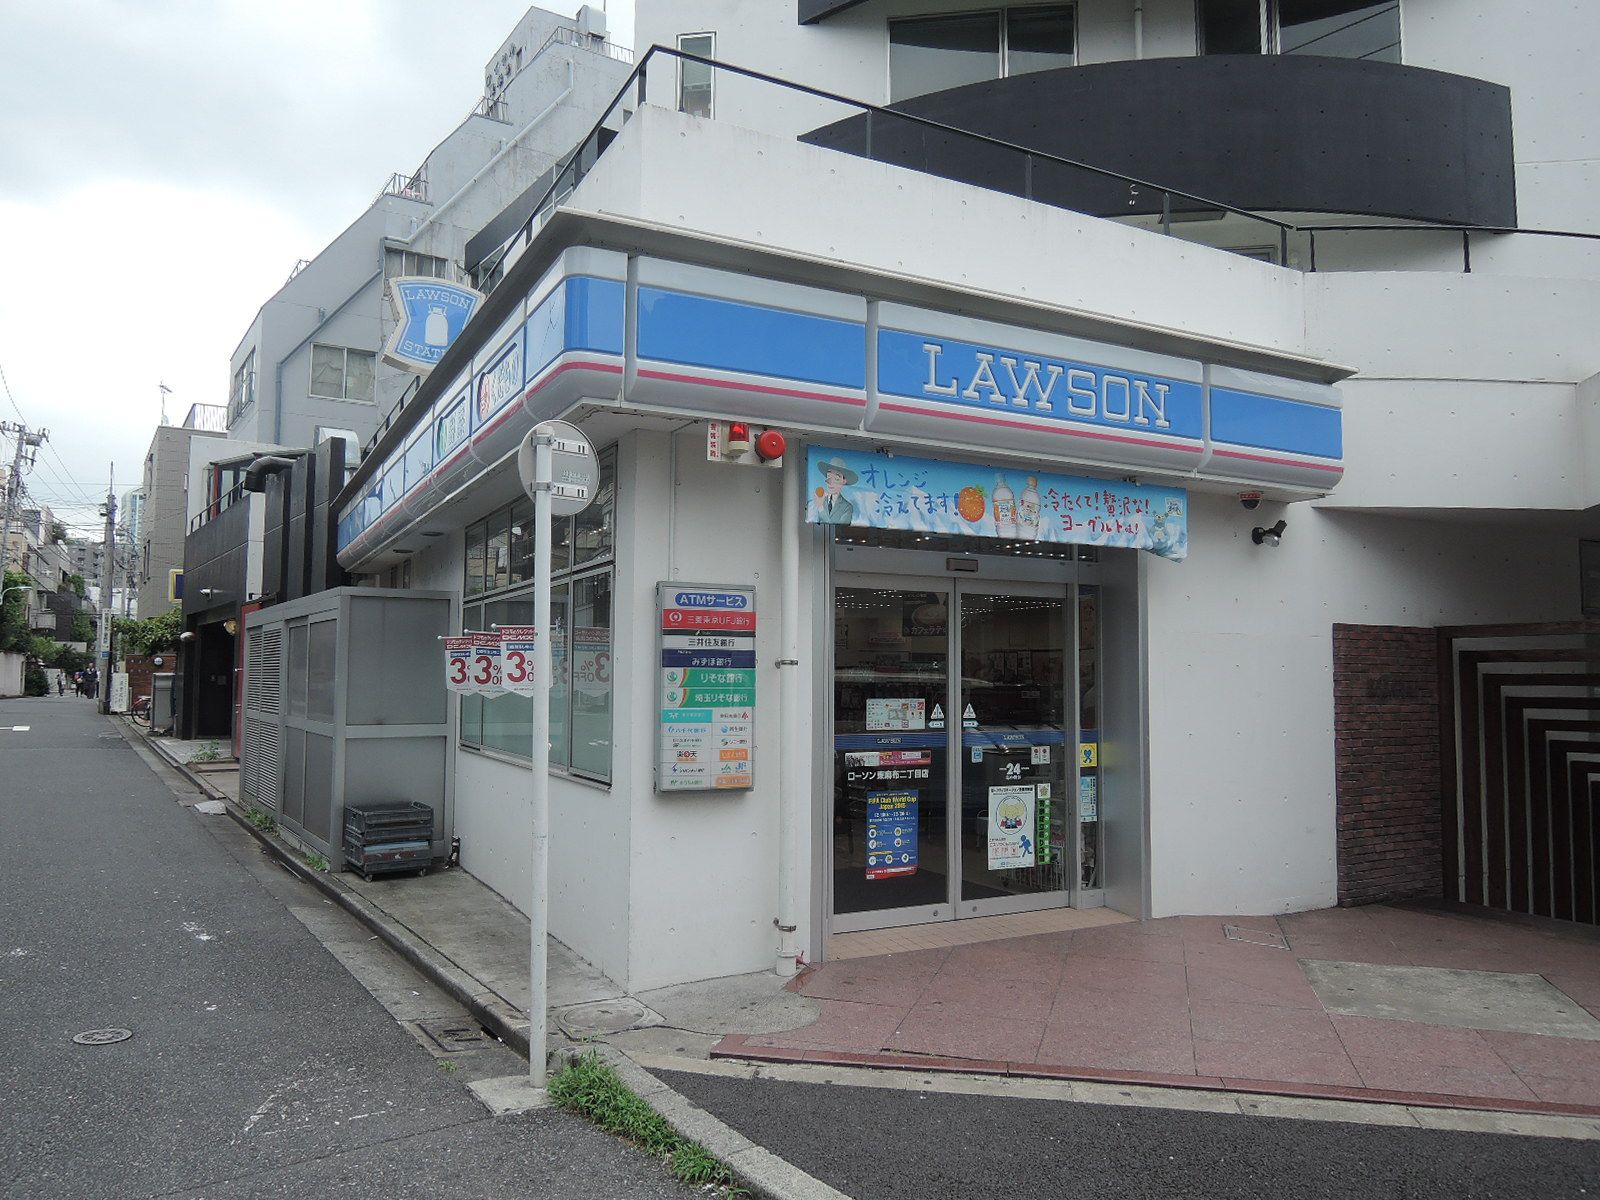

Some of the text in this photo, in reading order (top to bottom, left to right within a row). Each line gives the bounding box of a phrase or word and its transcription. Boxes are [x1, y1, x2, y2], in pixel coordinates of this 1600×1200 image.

[404, 289, 471, 309] LAWSON
[922, 343, 1170, 428] LAWSON
[861, 463, 929, 489] オレンジ
[875, 492, 960, 517] 冷えてます!
[680, 594, 744, 607] ATMサービス
[687, 615, 750, 626] 三菱東京UFJ銀行
[688, 638, 736, 647] 三井住友銀行
[692, 657, 732, 666] みずほ銀行
[701, 671, 743, 682] りそな銀行
[695, 693, 748, 703] 埼玉りそな銀行
[1006, 763, 1021, 775] 24
